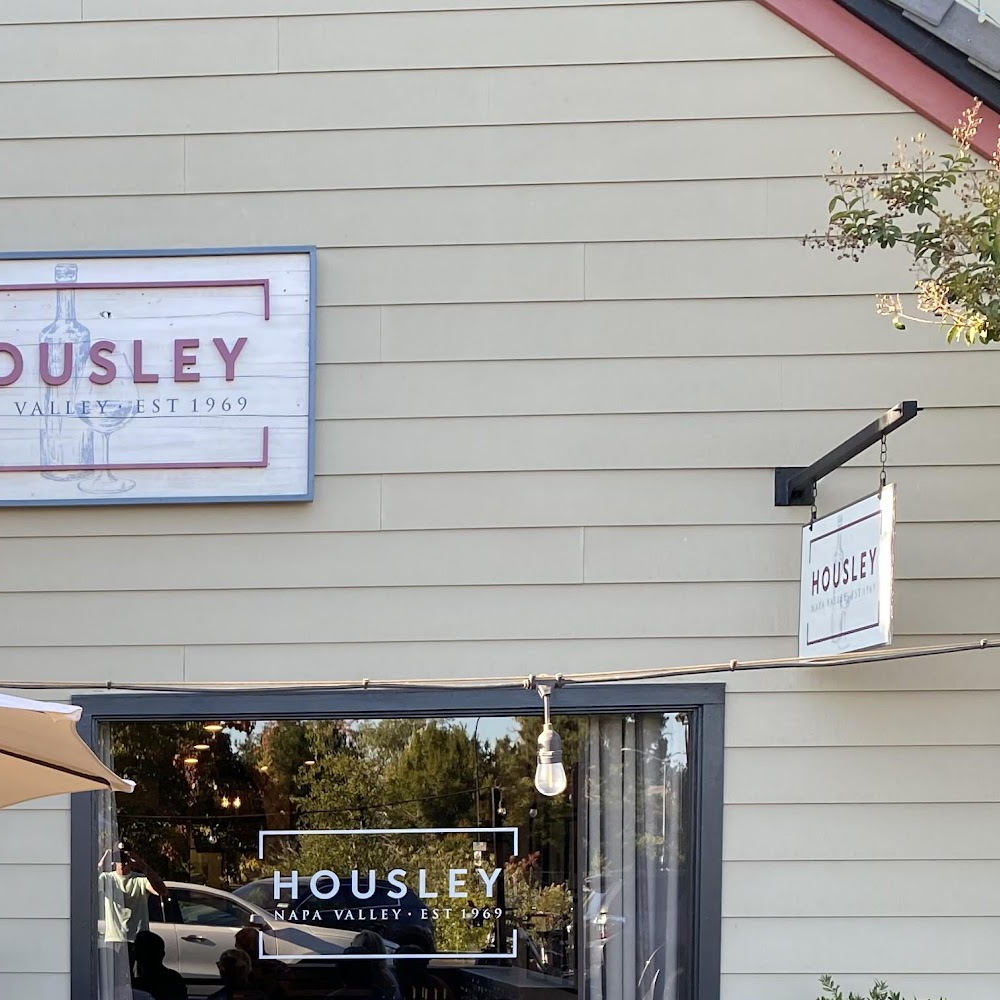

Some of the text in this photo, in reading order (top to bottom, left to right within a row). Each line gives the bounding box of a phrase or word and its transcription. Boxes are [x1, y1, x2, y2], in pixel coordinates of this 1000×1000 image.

[14, 399, 108, 416] VALLEY
[136, 398, 180, 414] EST
[190, 396, 248, 413] 1969
[811, 547, 877, 596] HOUSLEY
[273, 867, 503, 899] HOUSLEY
[274, 907, 503, 921] NAPA VALLEY EST 1969
